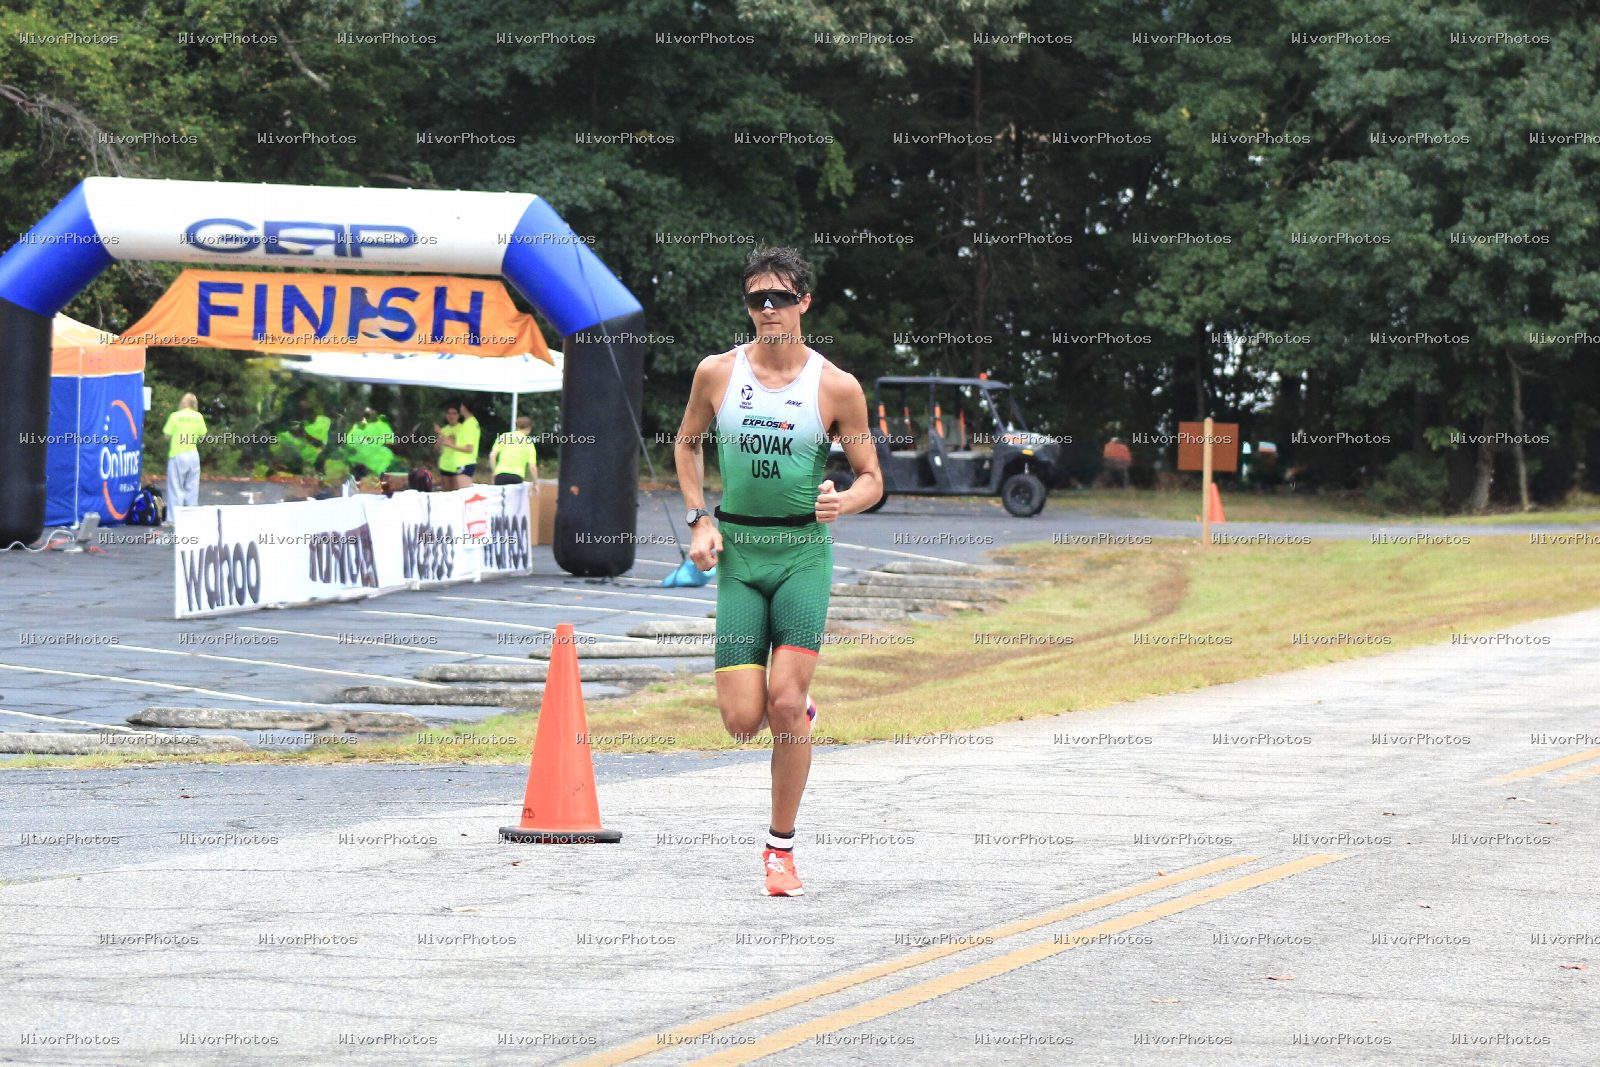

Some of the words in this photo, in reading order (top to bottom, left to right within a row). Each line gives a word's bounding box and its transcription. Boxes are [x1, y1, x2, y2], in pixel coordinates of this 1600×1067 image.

[197, 280, 485, 347] FINISH
[740, 433, 793, 456] KOVAK
[751, 460, 781, 479] USA
[181, 508, 261, 612] wahoo
